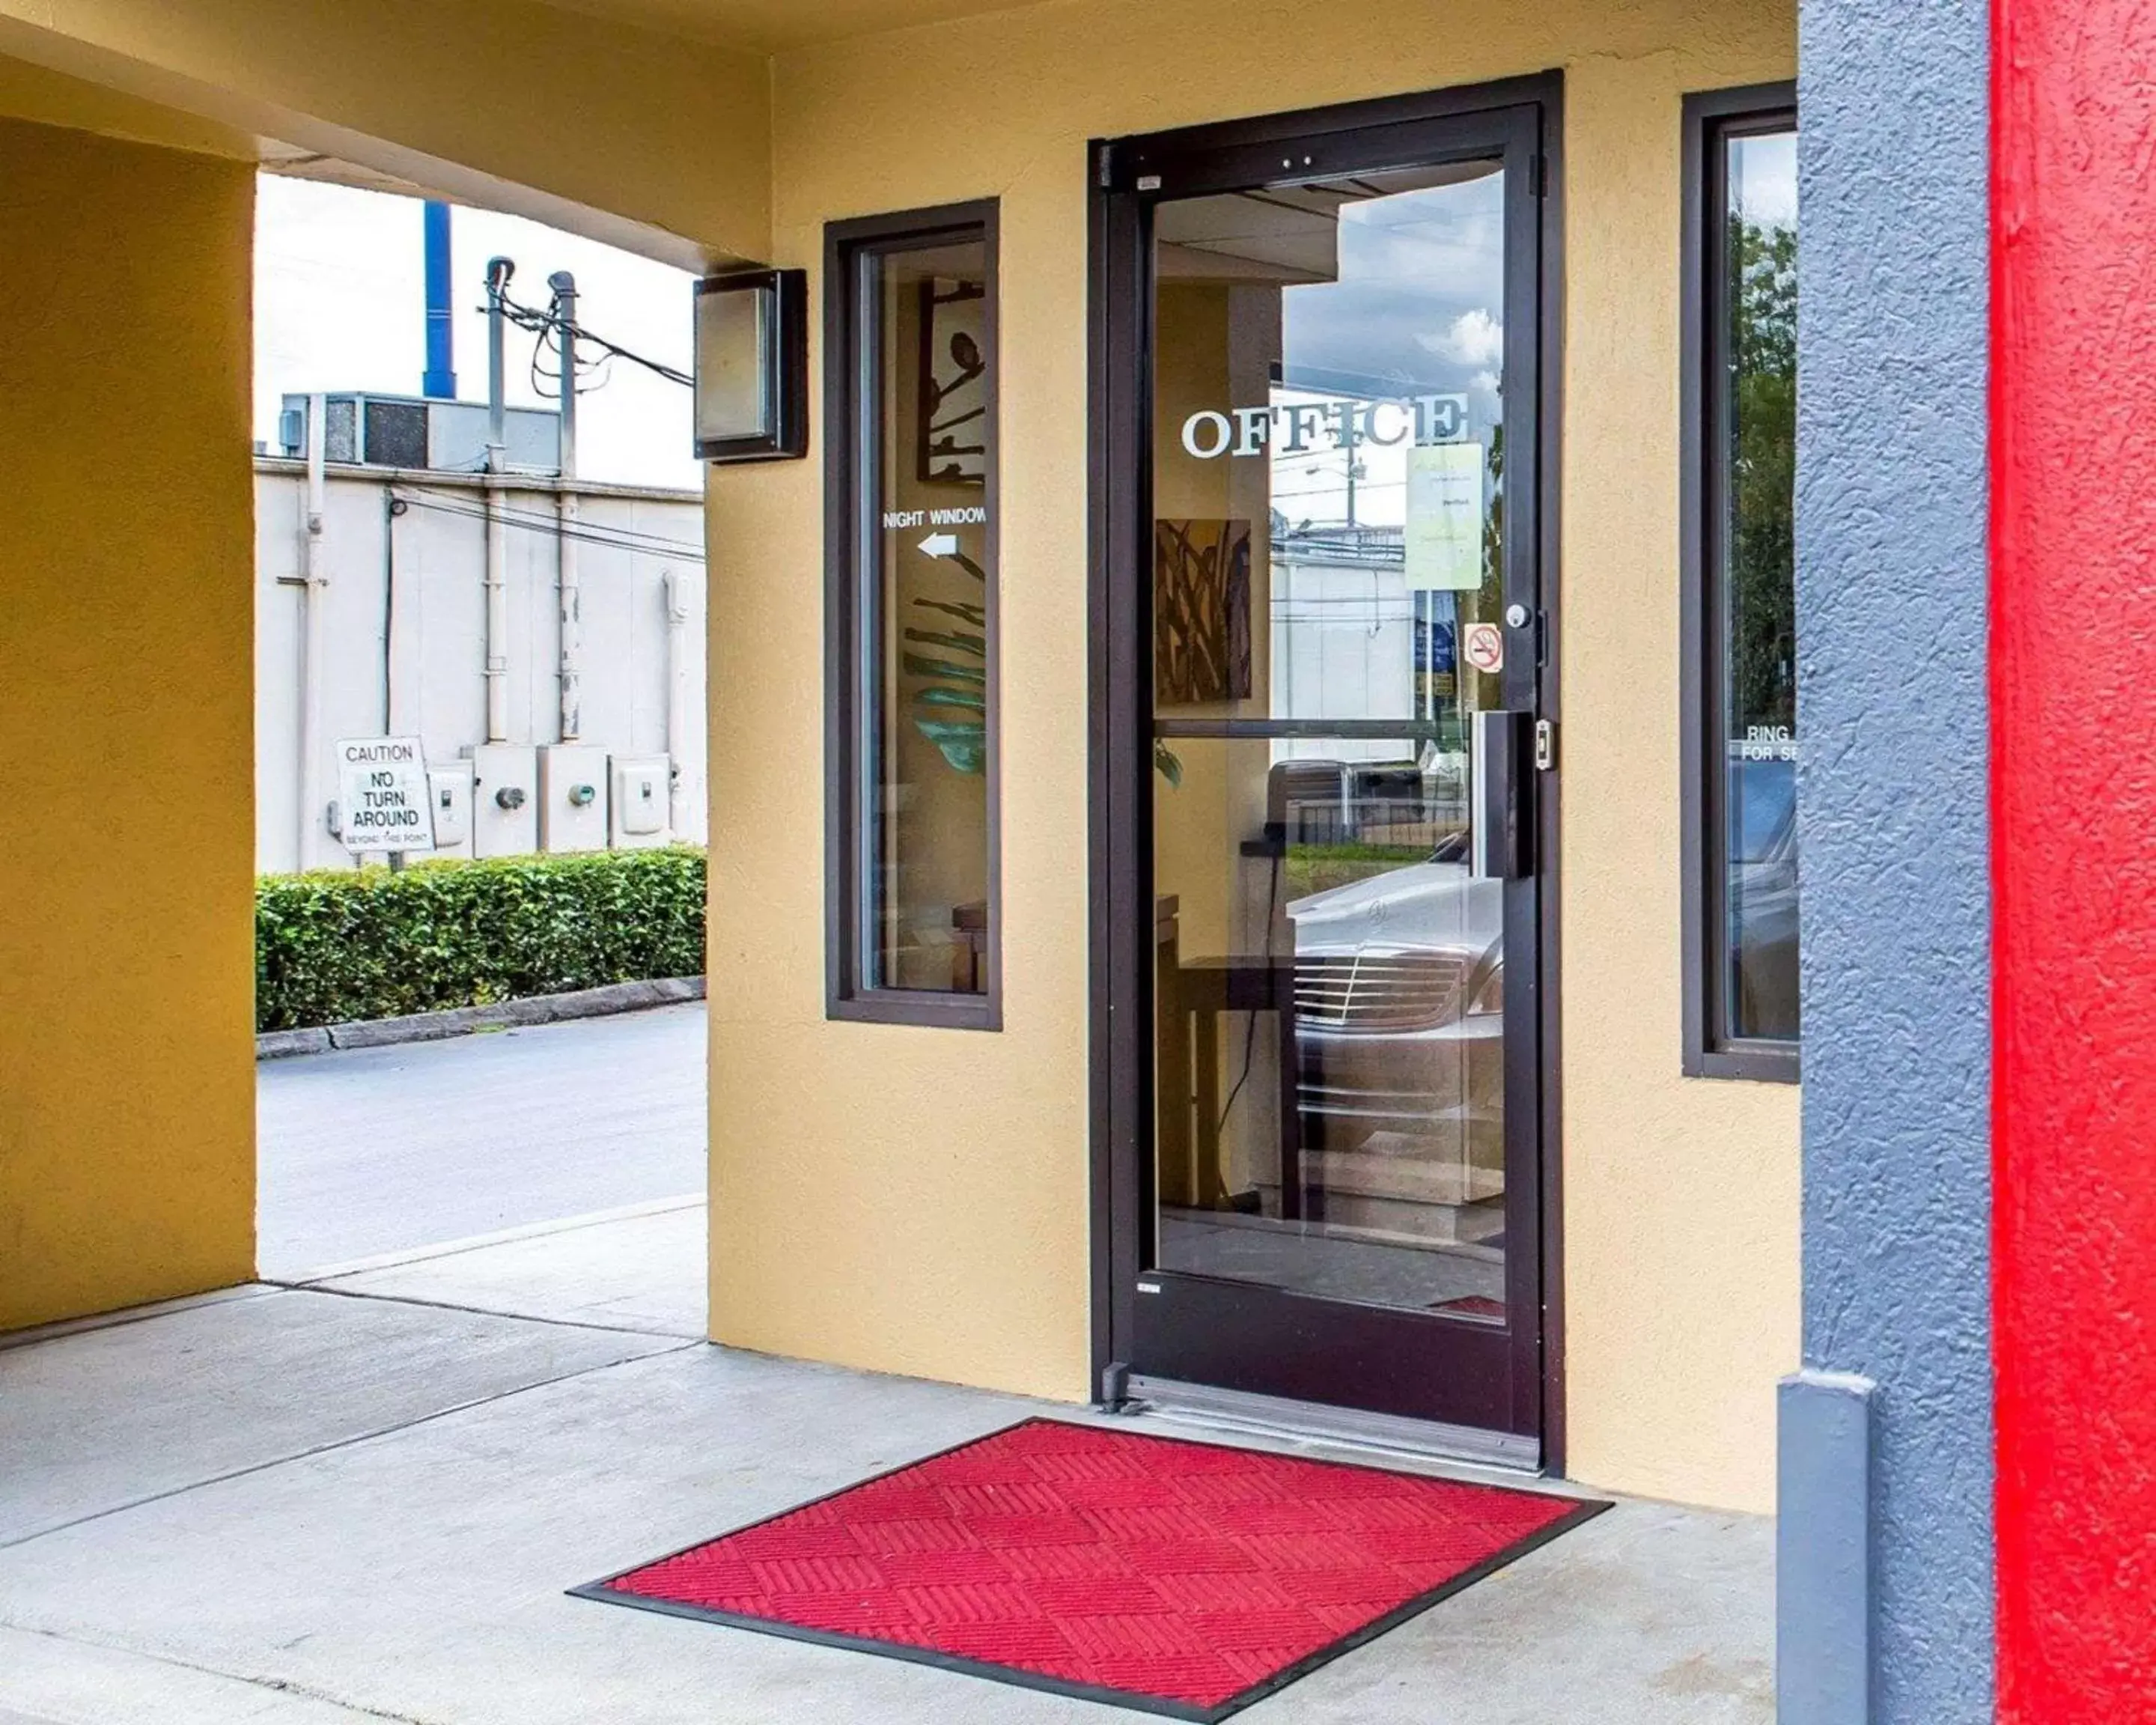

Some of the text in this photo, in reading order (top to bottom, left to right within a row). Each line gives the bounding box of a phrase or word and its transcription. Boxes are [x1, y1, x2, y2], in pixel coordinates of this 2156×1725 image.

[1181, 392, 1470, 459] OFFICE
[883, 510, 925, 529] NIGHT
[1747, 725, 1789, 743] RING
[345, 744, 412, 762] CAUTION
[1741, 746, 1773, 761] FOR
[371, 771, 394, 787] NO
[363, 791, 405, 807] TURN
[353, 810, 419, 827] AROUND
